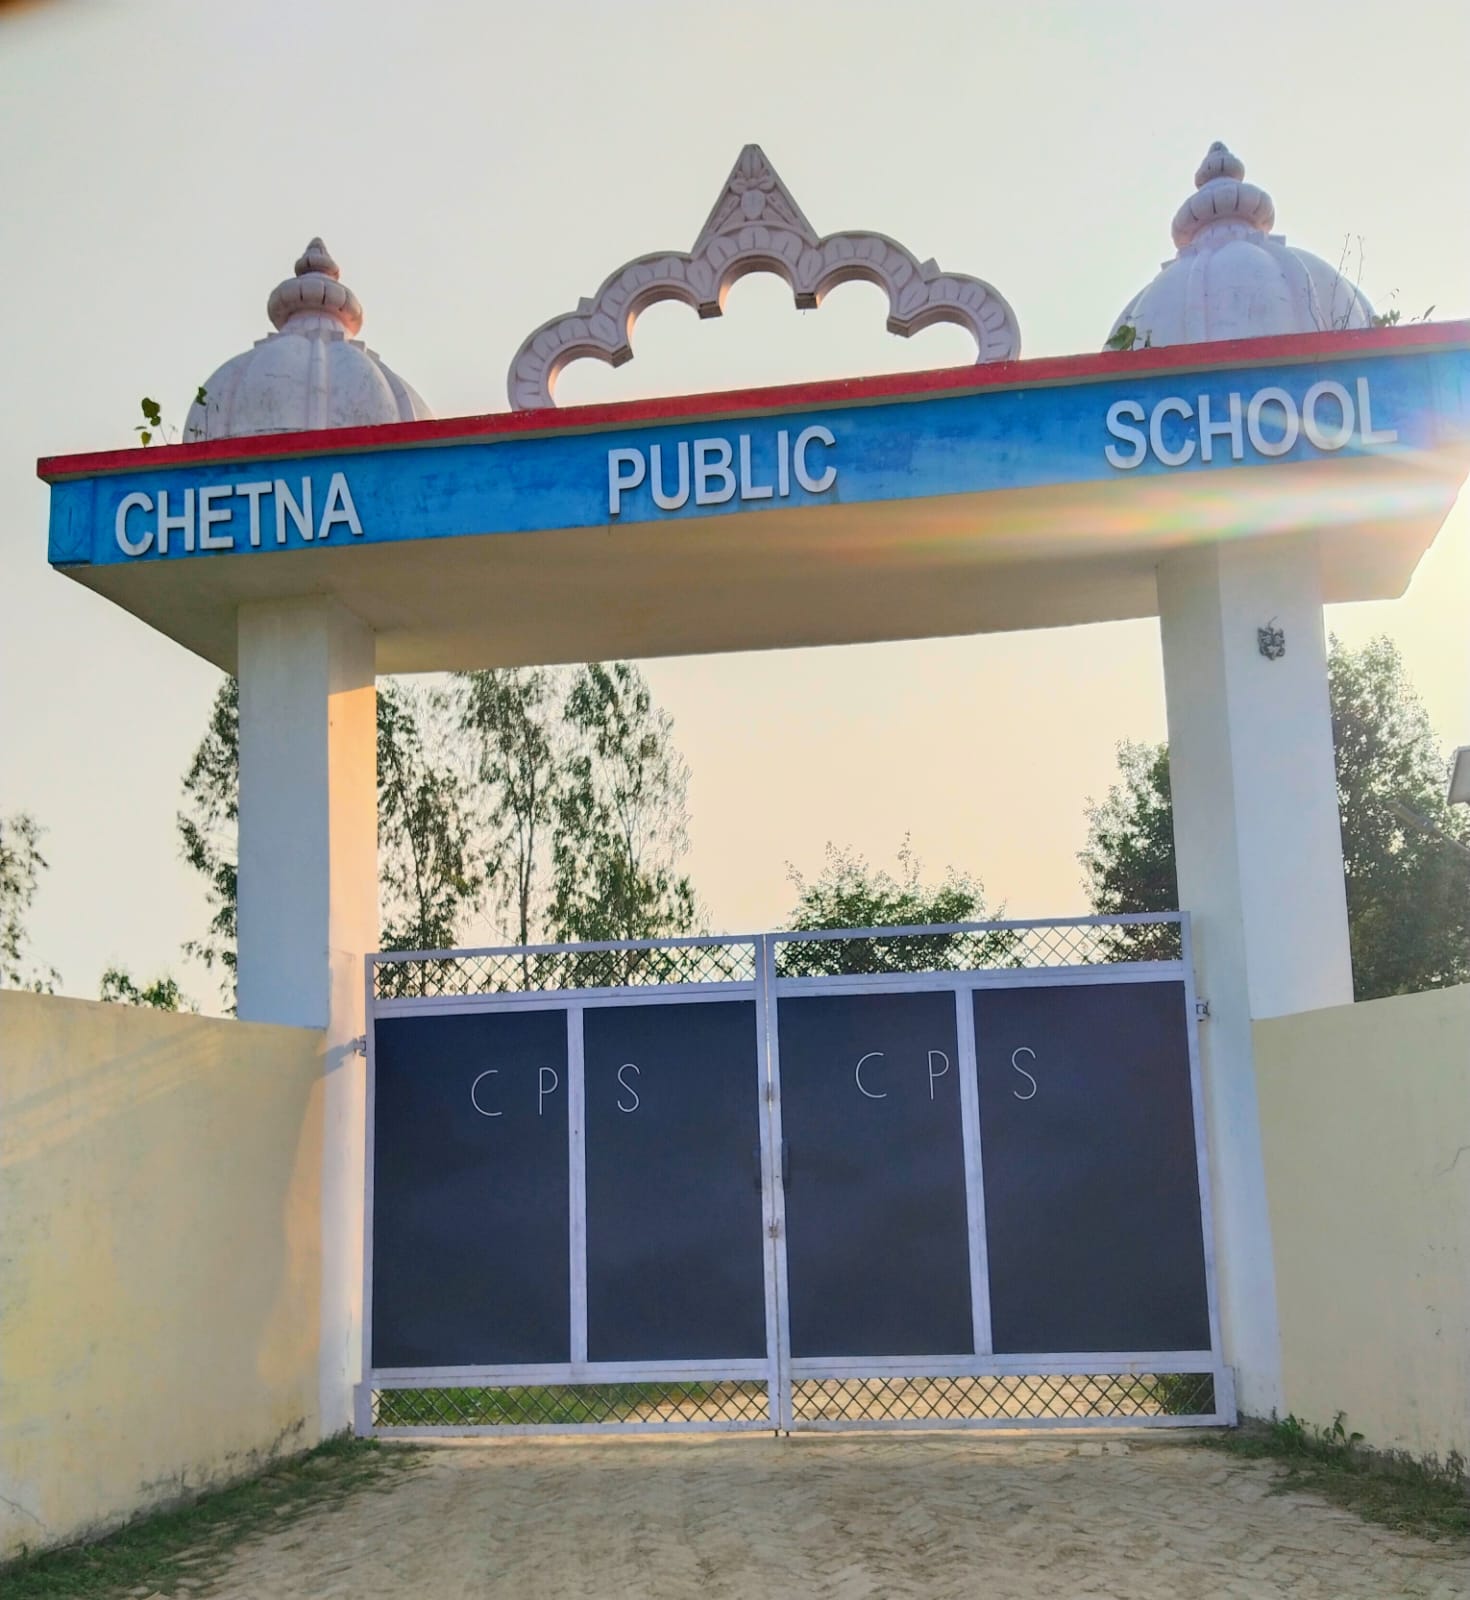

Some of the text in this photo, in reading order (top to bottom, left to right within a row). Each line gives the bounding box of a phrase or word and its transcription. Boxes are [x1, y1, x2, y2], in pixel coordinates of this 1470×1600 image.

[114, 376, 1399, 557] CHETNA PUBLIC SCHOOL
